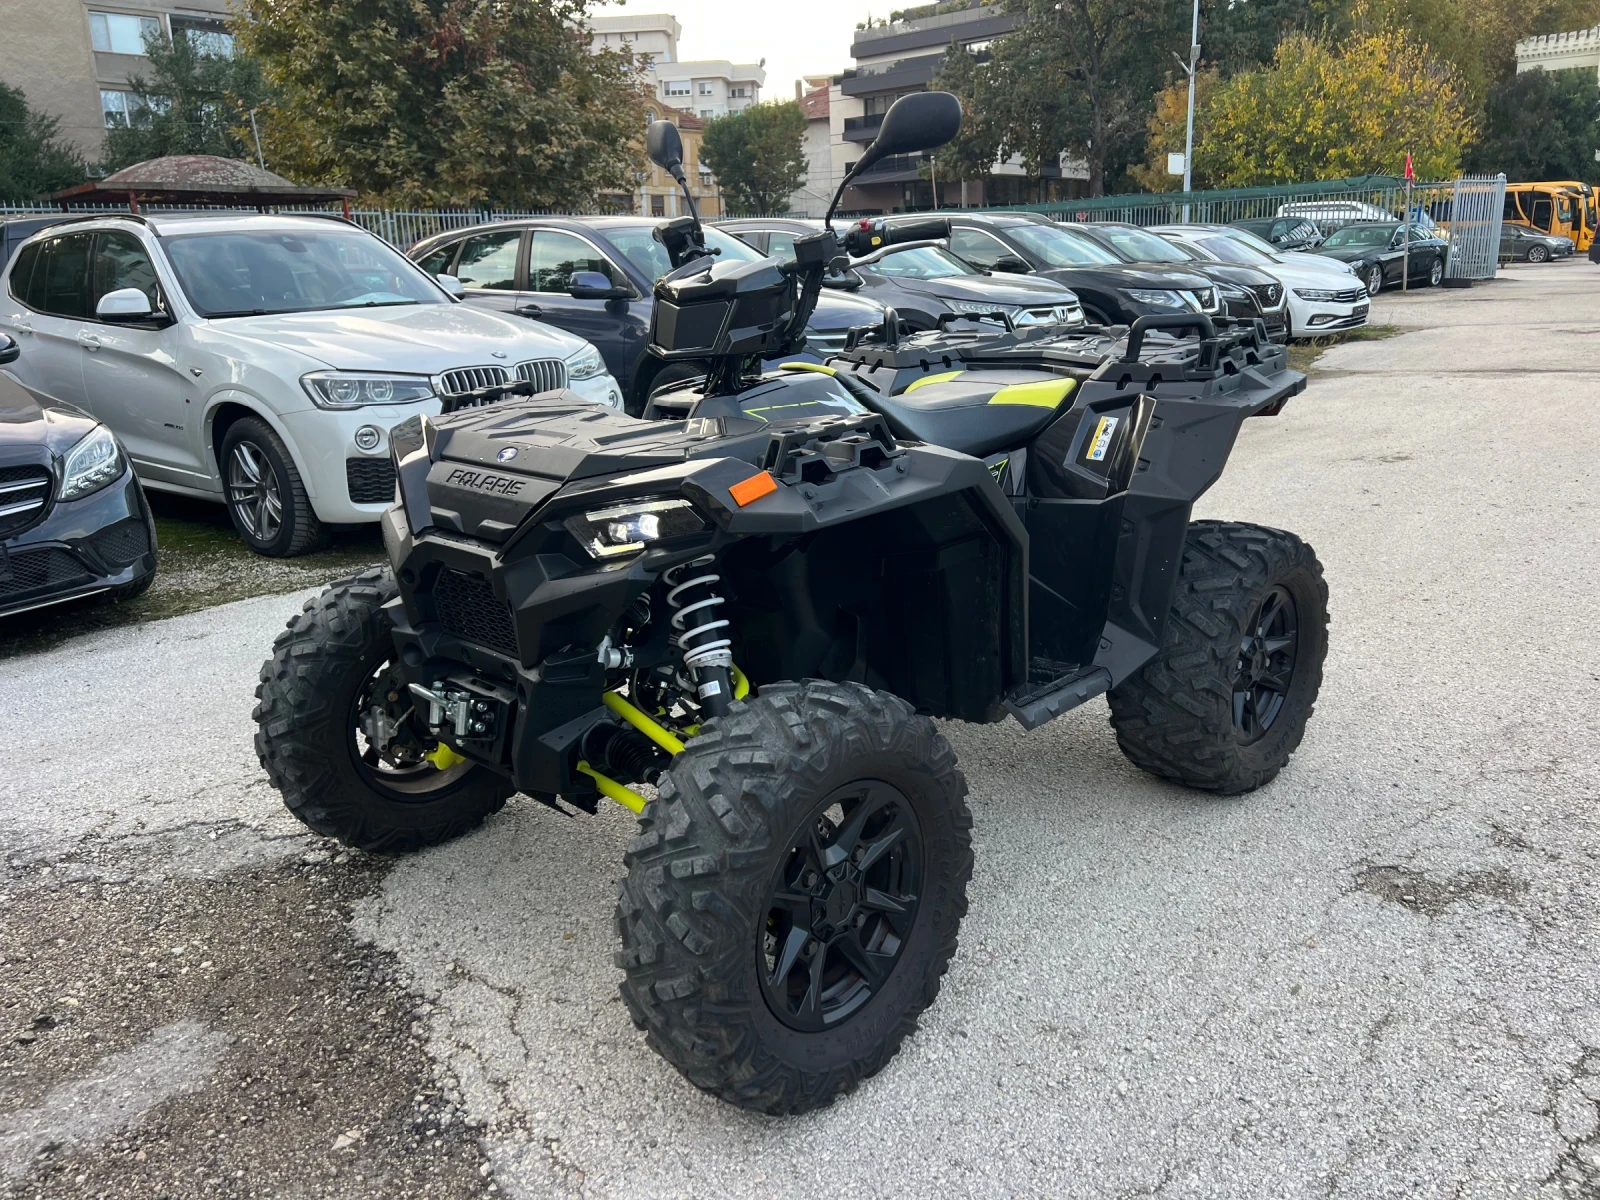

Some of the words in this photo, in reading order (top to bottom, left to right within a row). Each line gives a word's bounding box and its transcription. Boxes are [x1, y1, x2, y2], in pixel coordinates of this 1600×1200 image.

[445, 469, 526, 495] POLARIS
[1263, 714, 1297, 762] DURO
[931, 838, 952, 930] DURO
